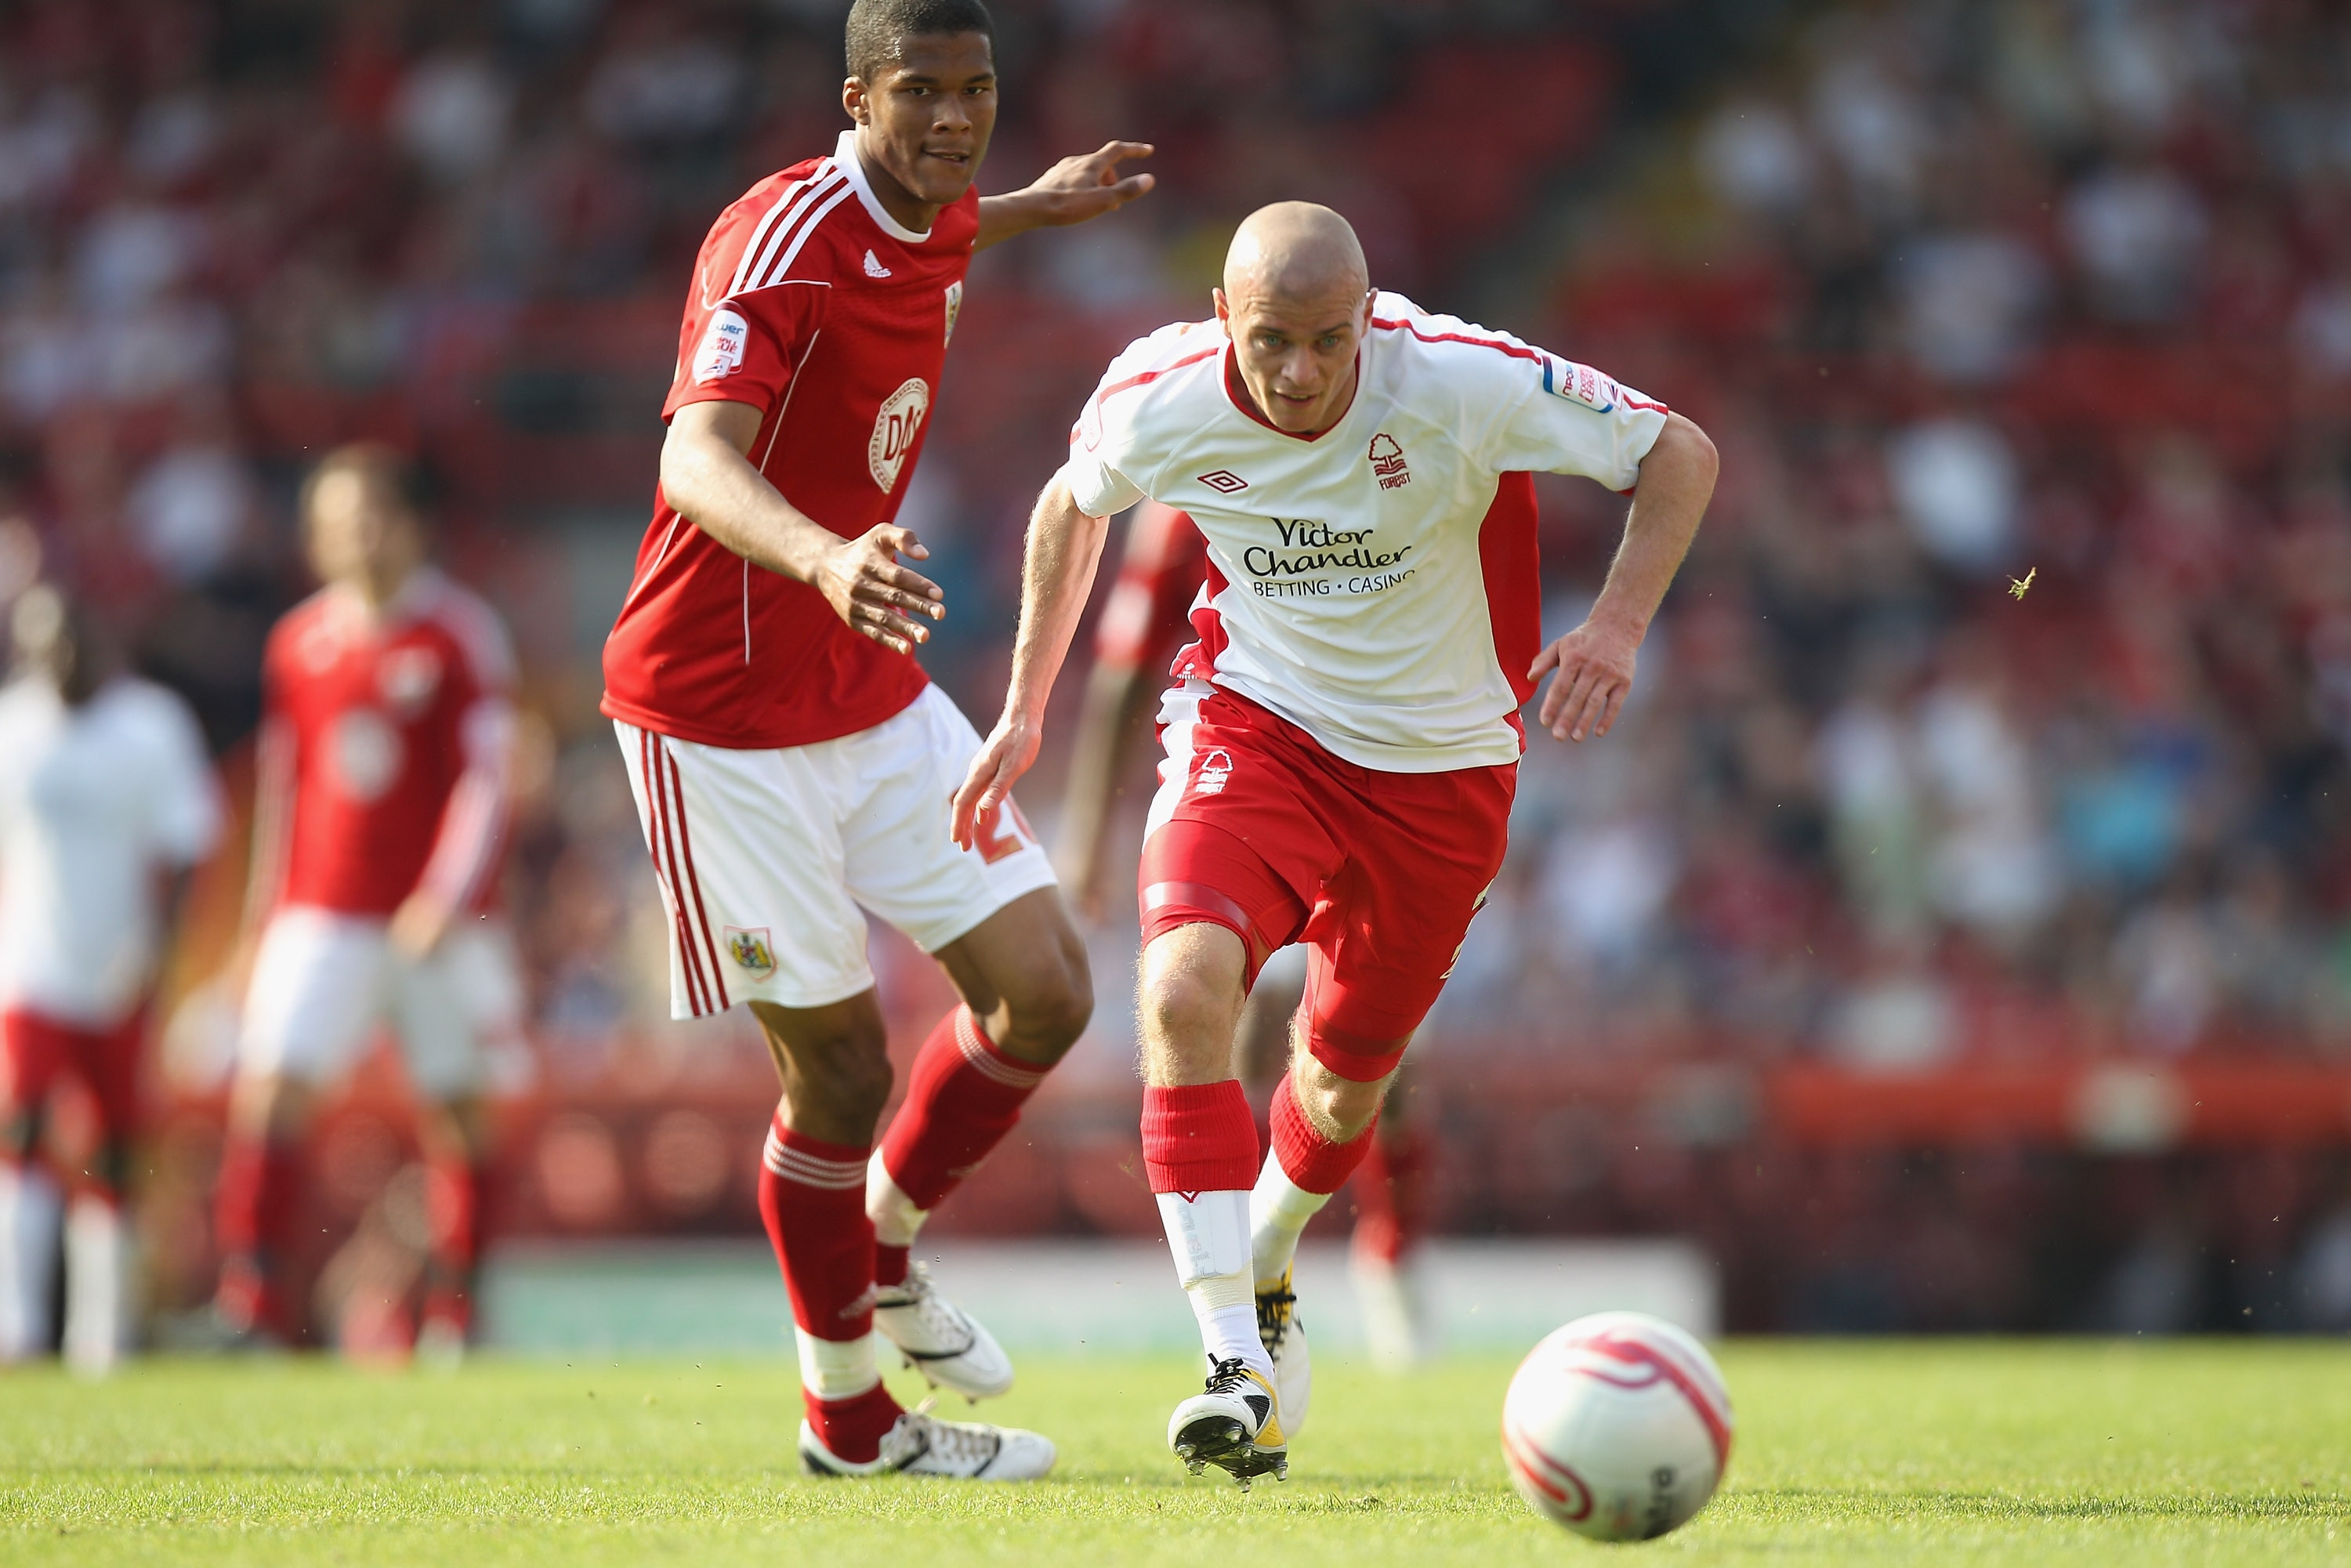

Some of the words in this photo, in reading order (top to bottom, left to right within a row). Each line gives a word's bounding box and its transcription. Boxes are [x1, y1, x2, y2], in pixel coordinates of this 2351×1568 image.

[1378, 472, 1411, 491] FOREST
[1269, 516, 1373, 548] Victor
[1243, 545, 1412, 577] Chandler
[1253, 579, 1330, 597] BETTING
